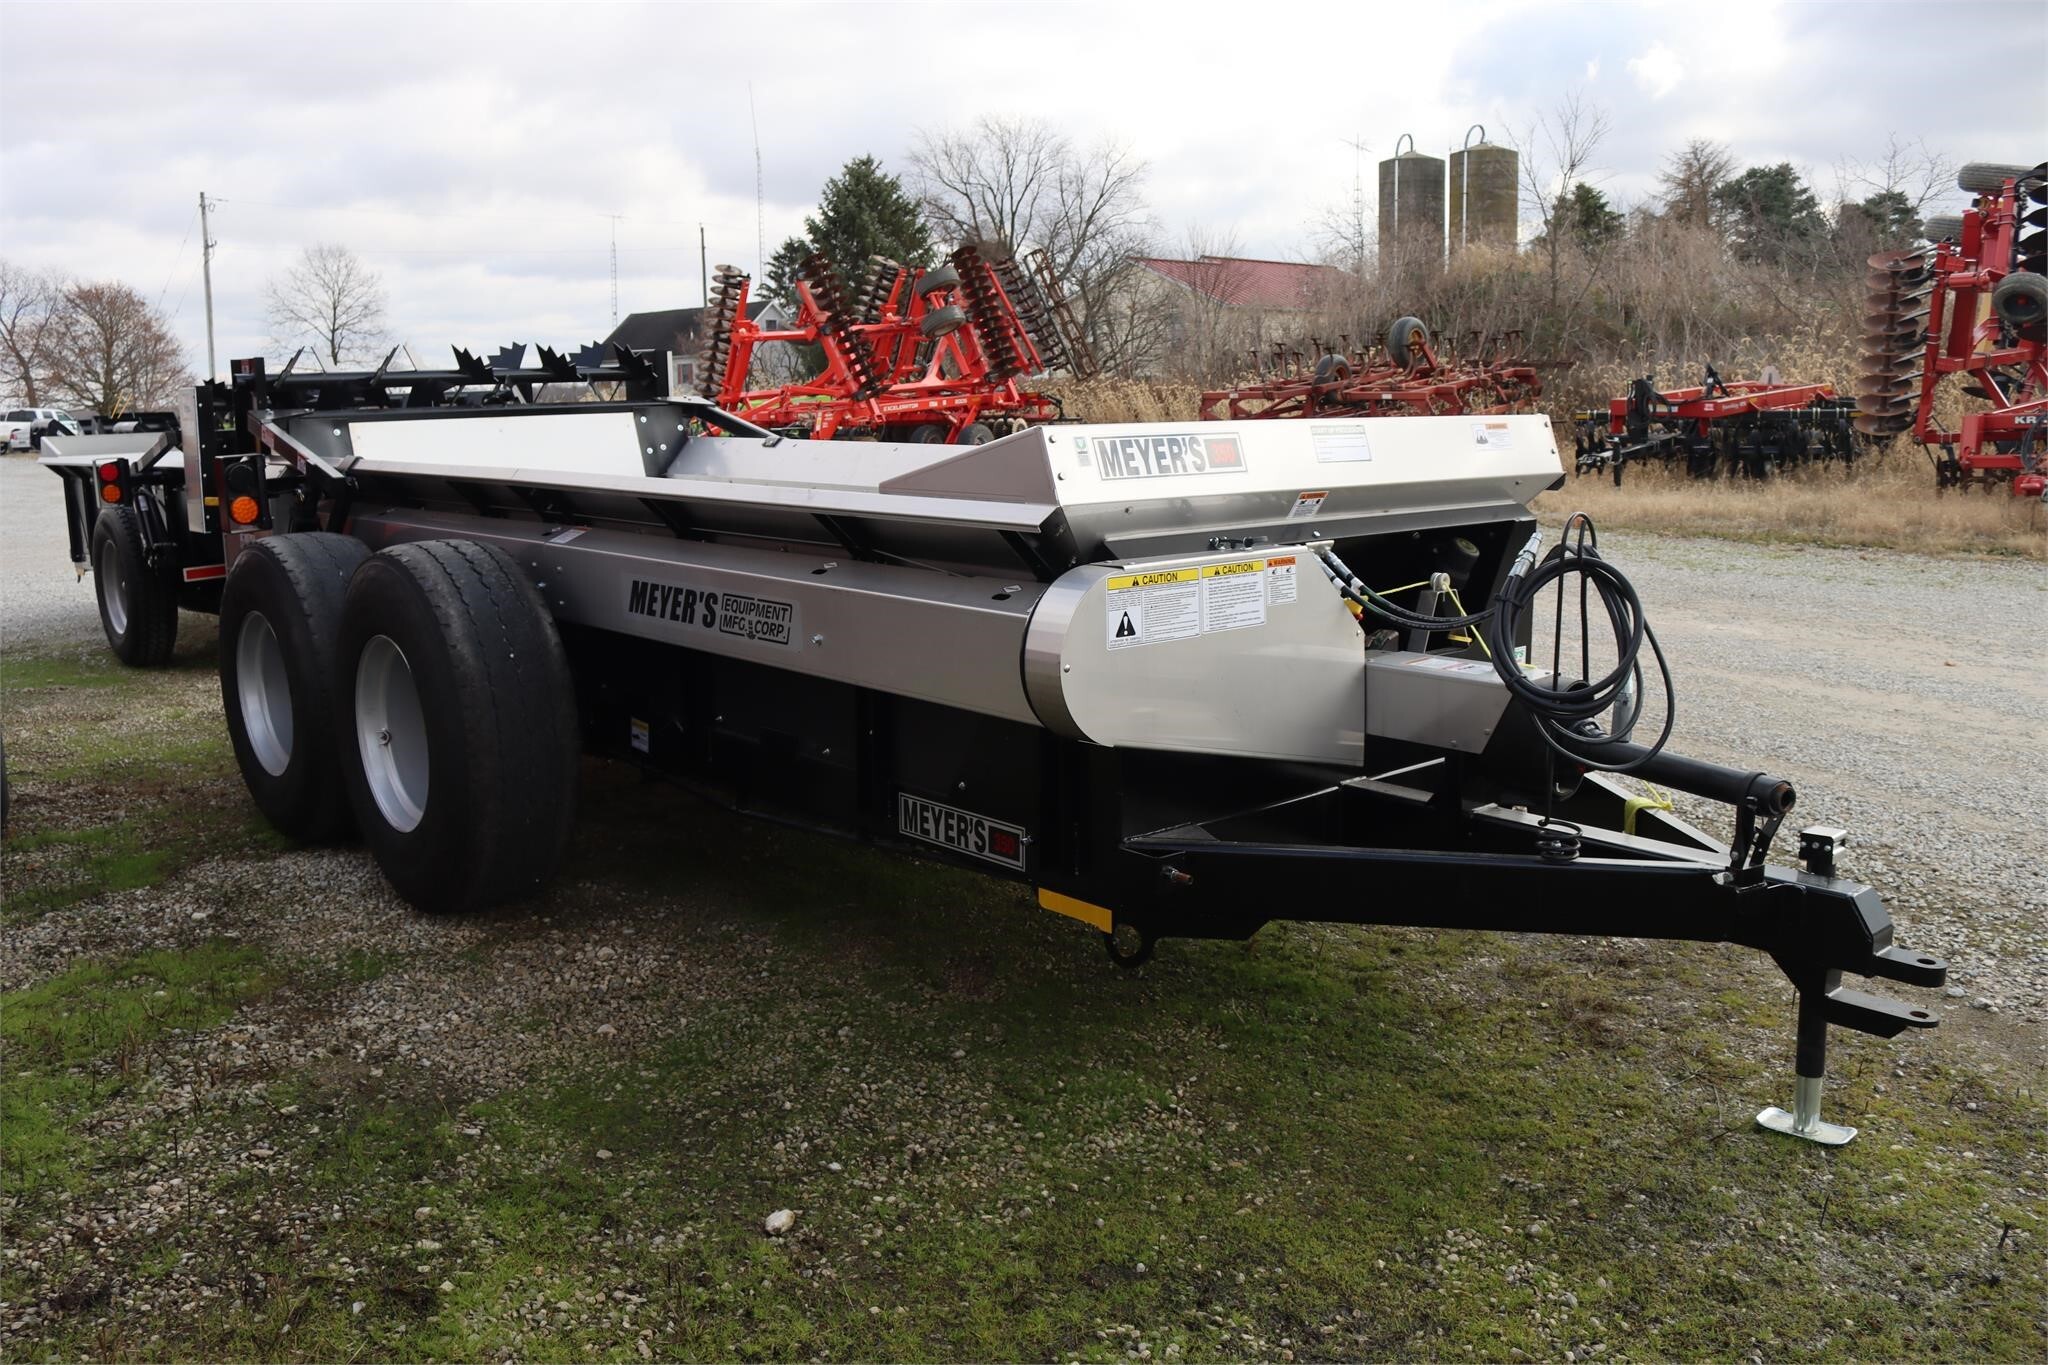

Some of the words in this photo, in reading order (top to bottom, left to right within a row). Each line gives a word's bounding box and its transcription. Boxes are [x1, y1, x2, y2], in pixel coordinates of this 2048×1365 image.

[1097, 436, 1206, 477] MEYER'S
[1142, 572, 1178, 585] CAUTION
[1222, 563, 1254, 575] CAUTION
[629, 580, 718, 628] MEYER'S
[724, 598, 788, 622] EQUIPMENT
[722, 615, 747, 632] MFG.
[754, 620, 786, 639] CORP.
[903, 797, 987, 854] MEYER'S
